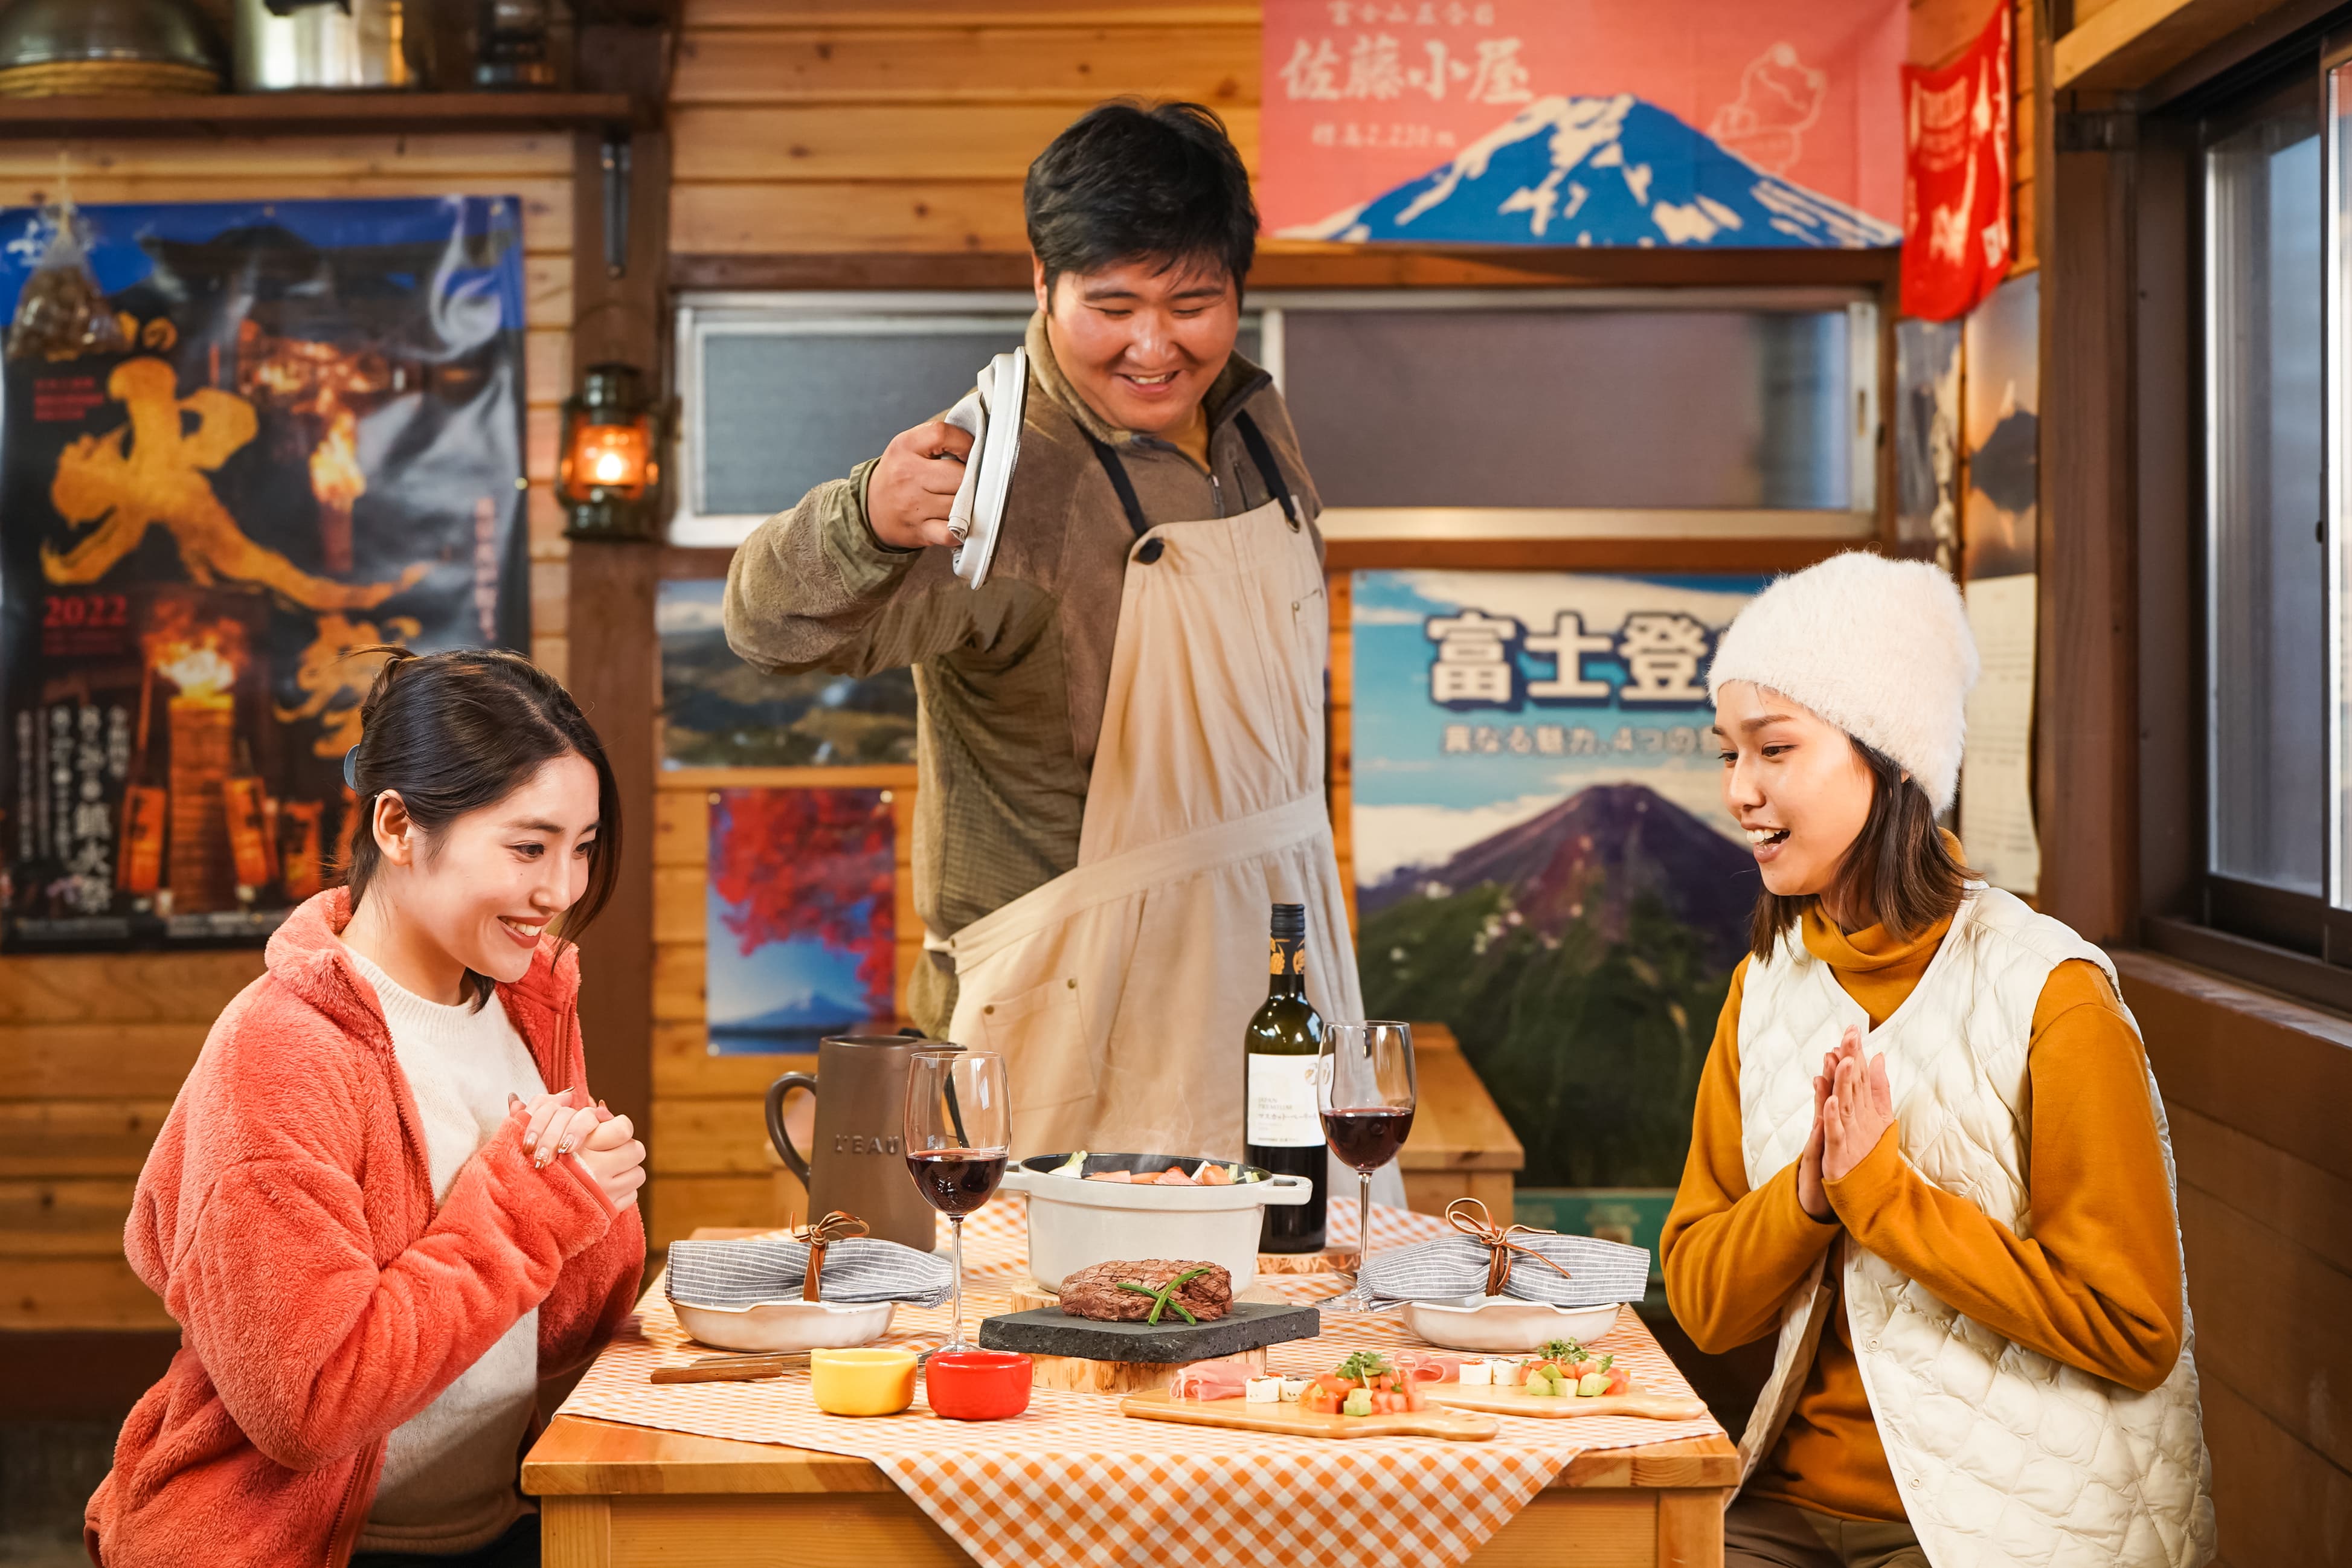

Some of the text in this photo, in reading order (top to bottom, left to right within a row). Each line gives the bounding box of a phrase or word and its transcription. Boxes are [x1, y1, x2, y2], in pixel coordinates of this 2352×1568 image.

[1279, 33, 1534, 104] 佐藤小屋
[43, 594, 127, 627] 2022
[1425, 608, 1727, 707] 富士登
[835, 1134, 900, 1155] L'EAU
